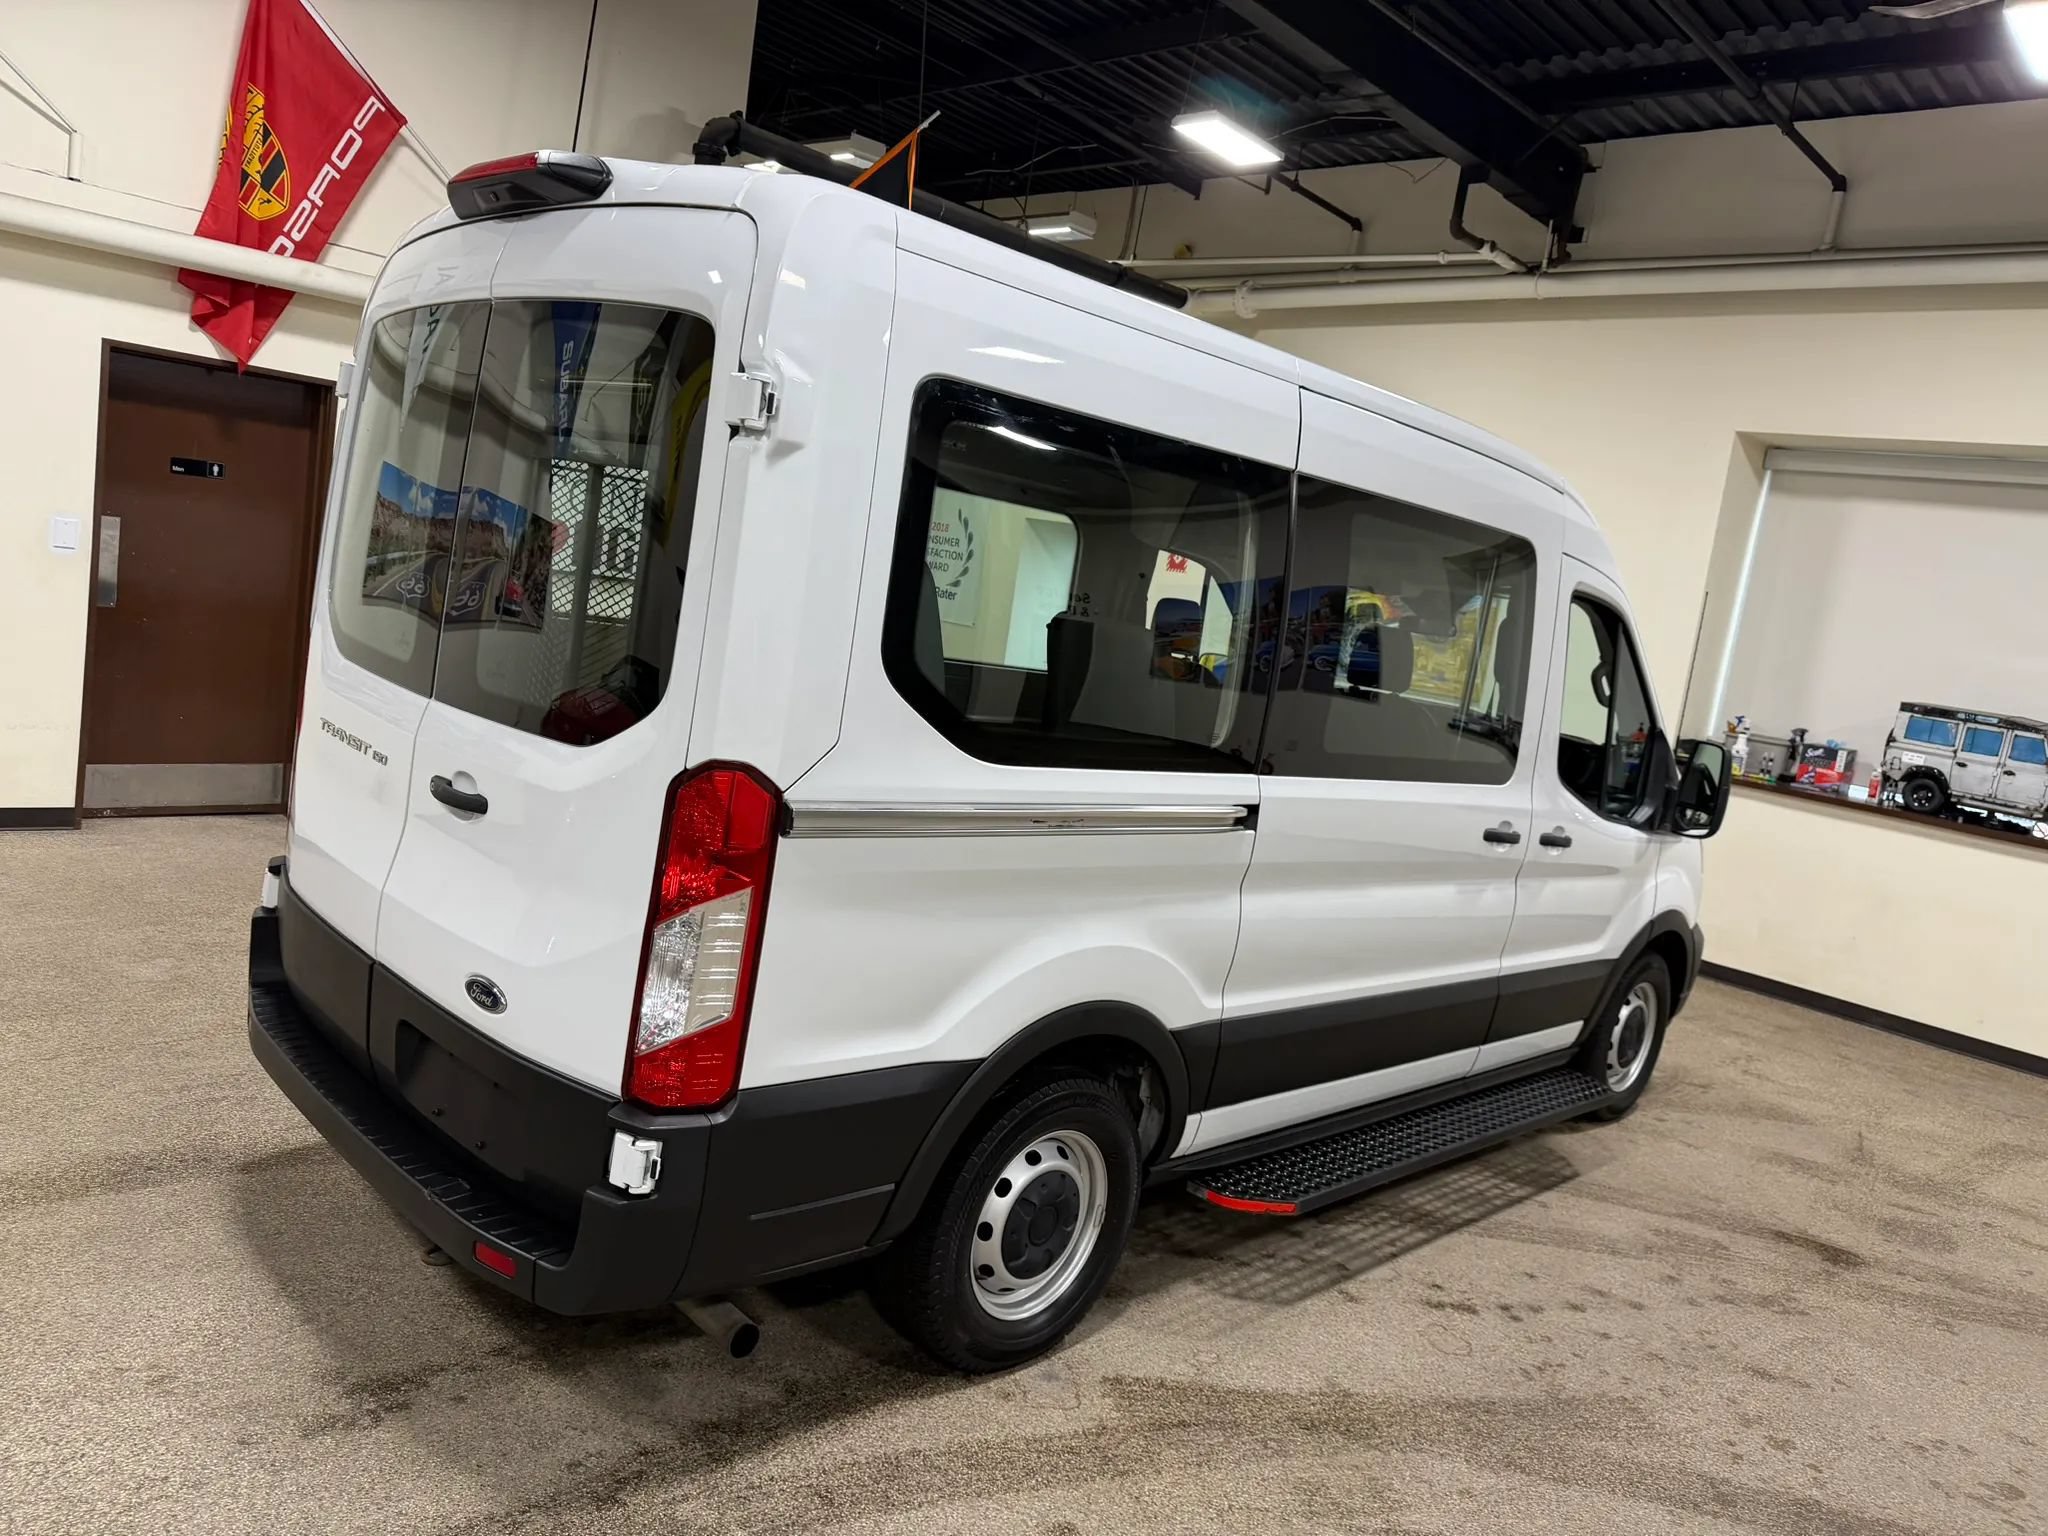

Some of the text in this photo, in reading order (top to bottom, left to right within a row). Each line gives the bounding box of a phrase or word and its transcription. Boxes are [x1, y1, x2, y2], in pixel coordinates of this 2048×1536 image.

[928, 535, 960, 548] NSUMER
[928, 548, 964, 561] FACTION
[320, 716, 373, 756] TRANSIT
[470, 982, 494, 1007] Ford
